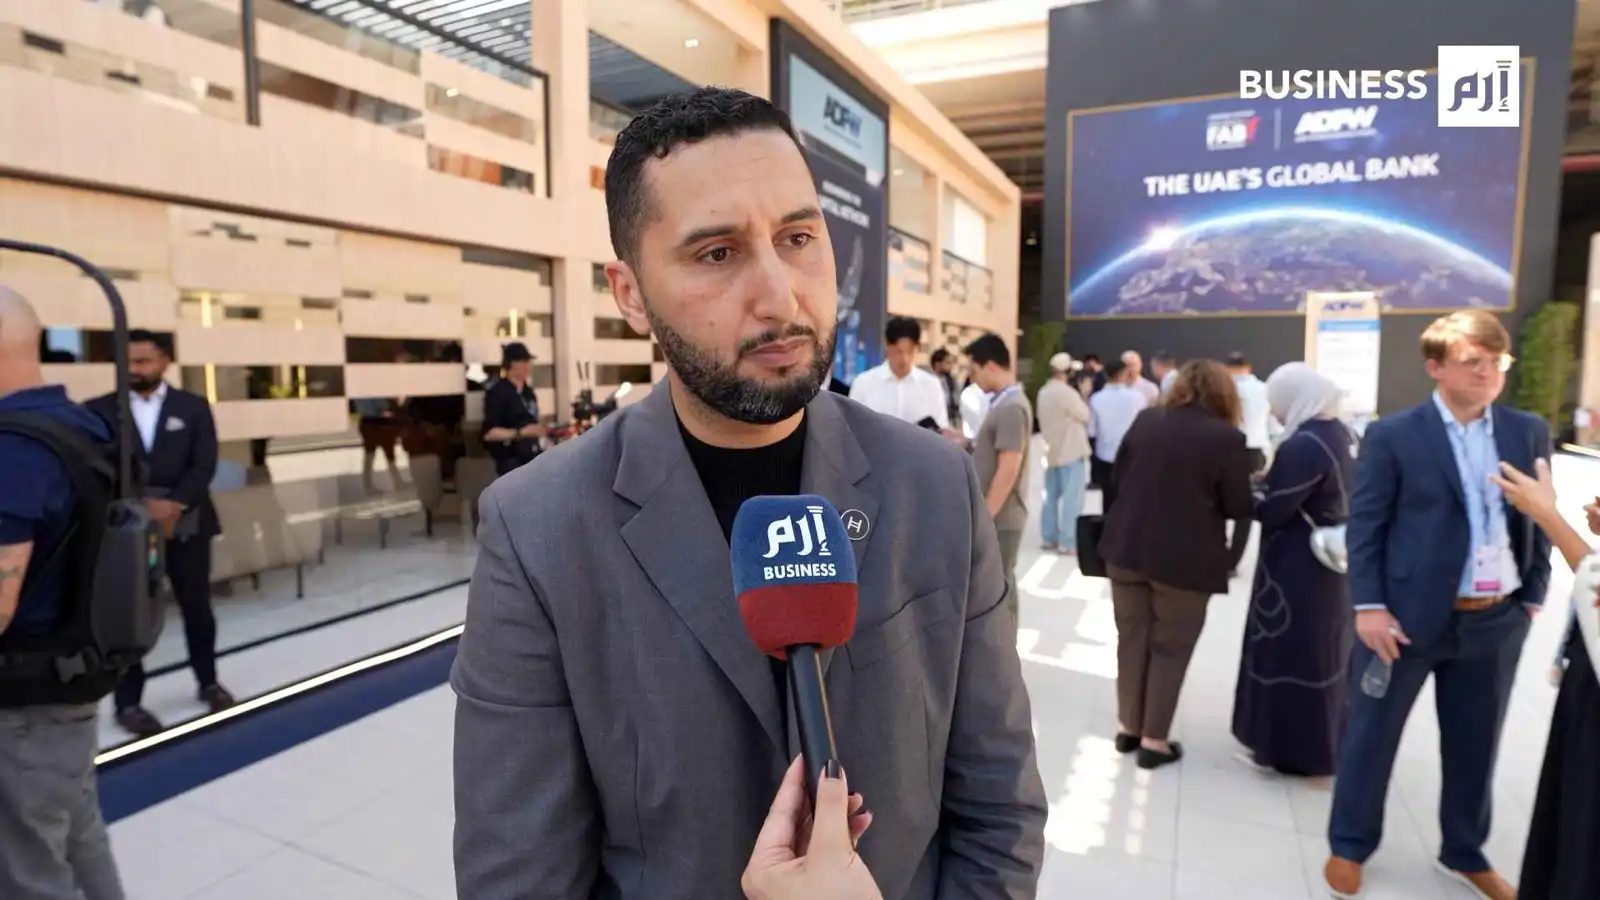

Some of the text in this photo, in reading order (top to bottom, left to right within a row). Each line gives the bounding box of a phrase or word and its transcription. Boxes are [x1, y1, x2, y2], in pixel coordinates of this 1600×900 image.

[1143, 153, 1440, 197] THE UAE'S GLOBAL BANK
[763, 563, 837, 580] BUSINESS
